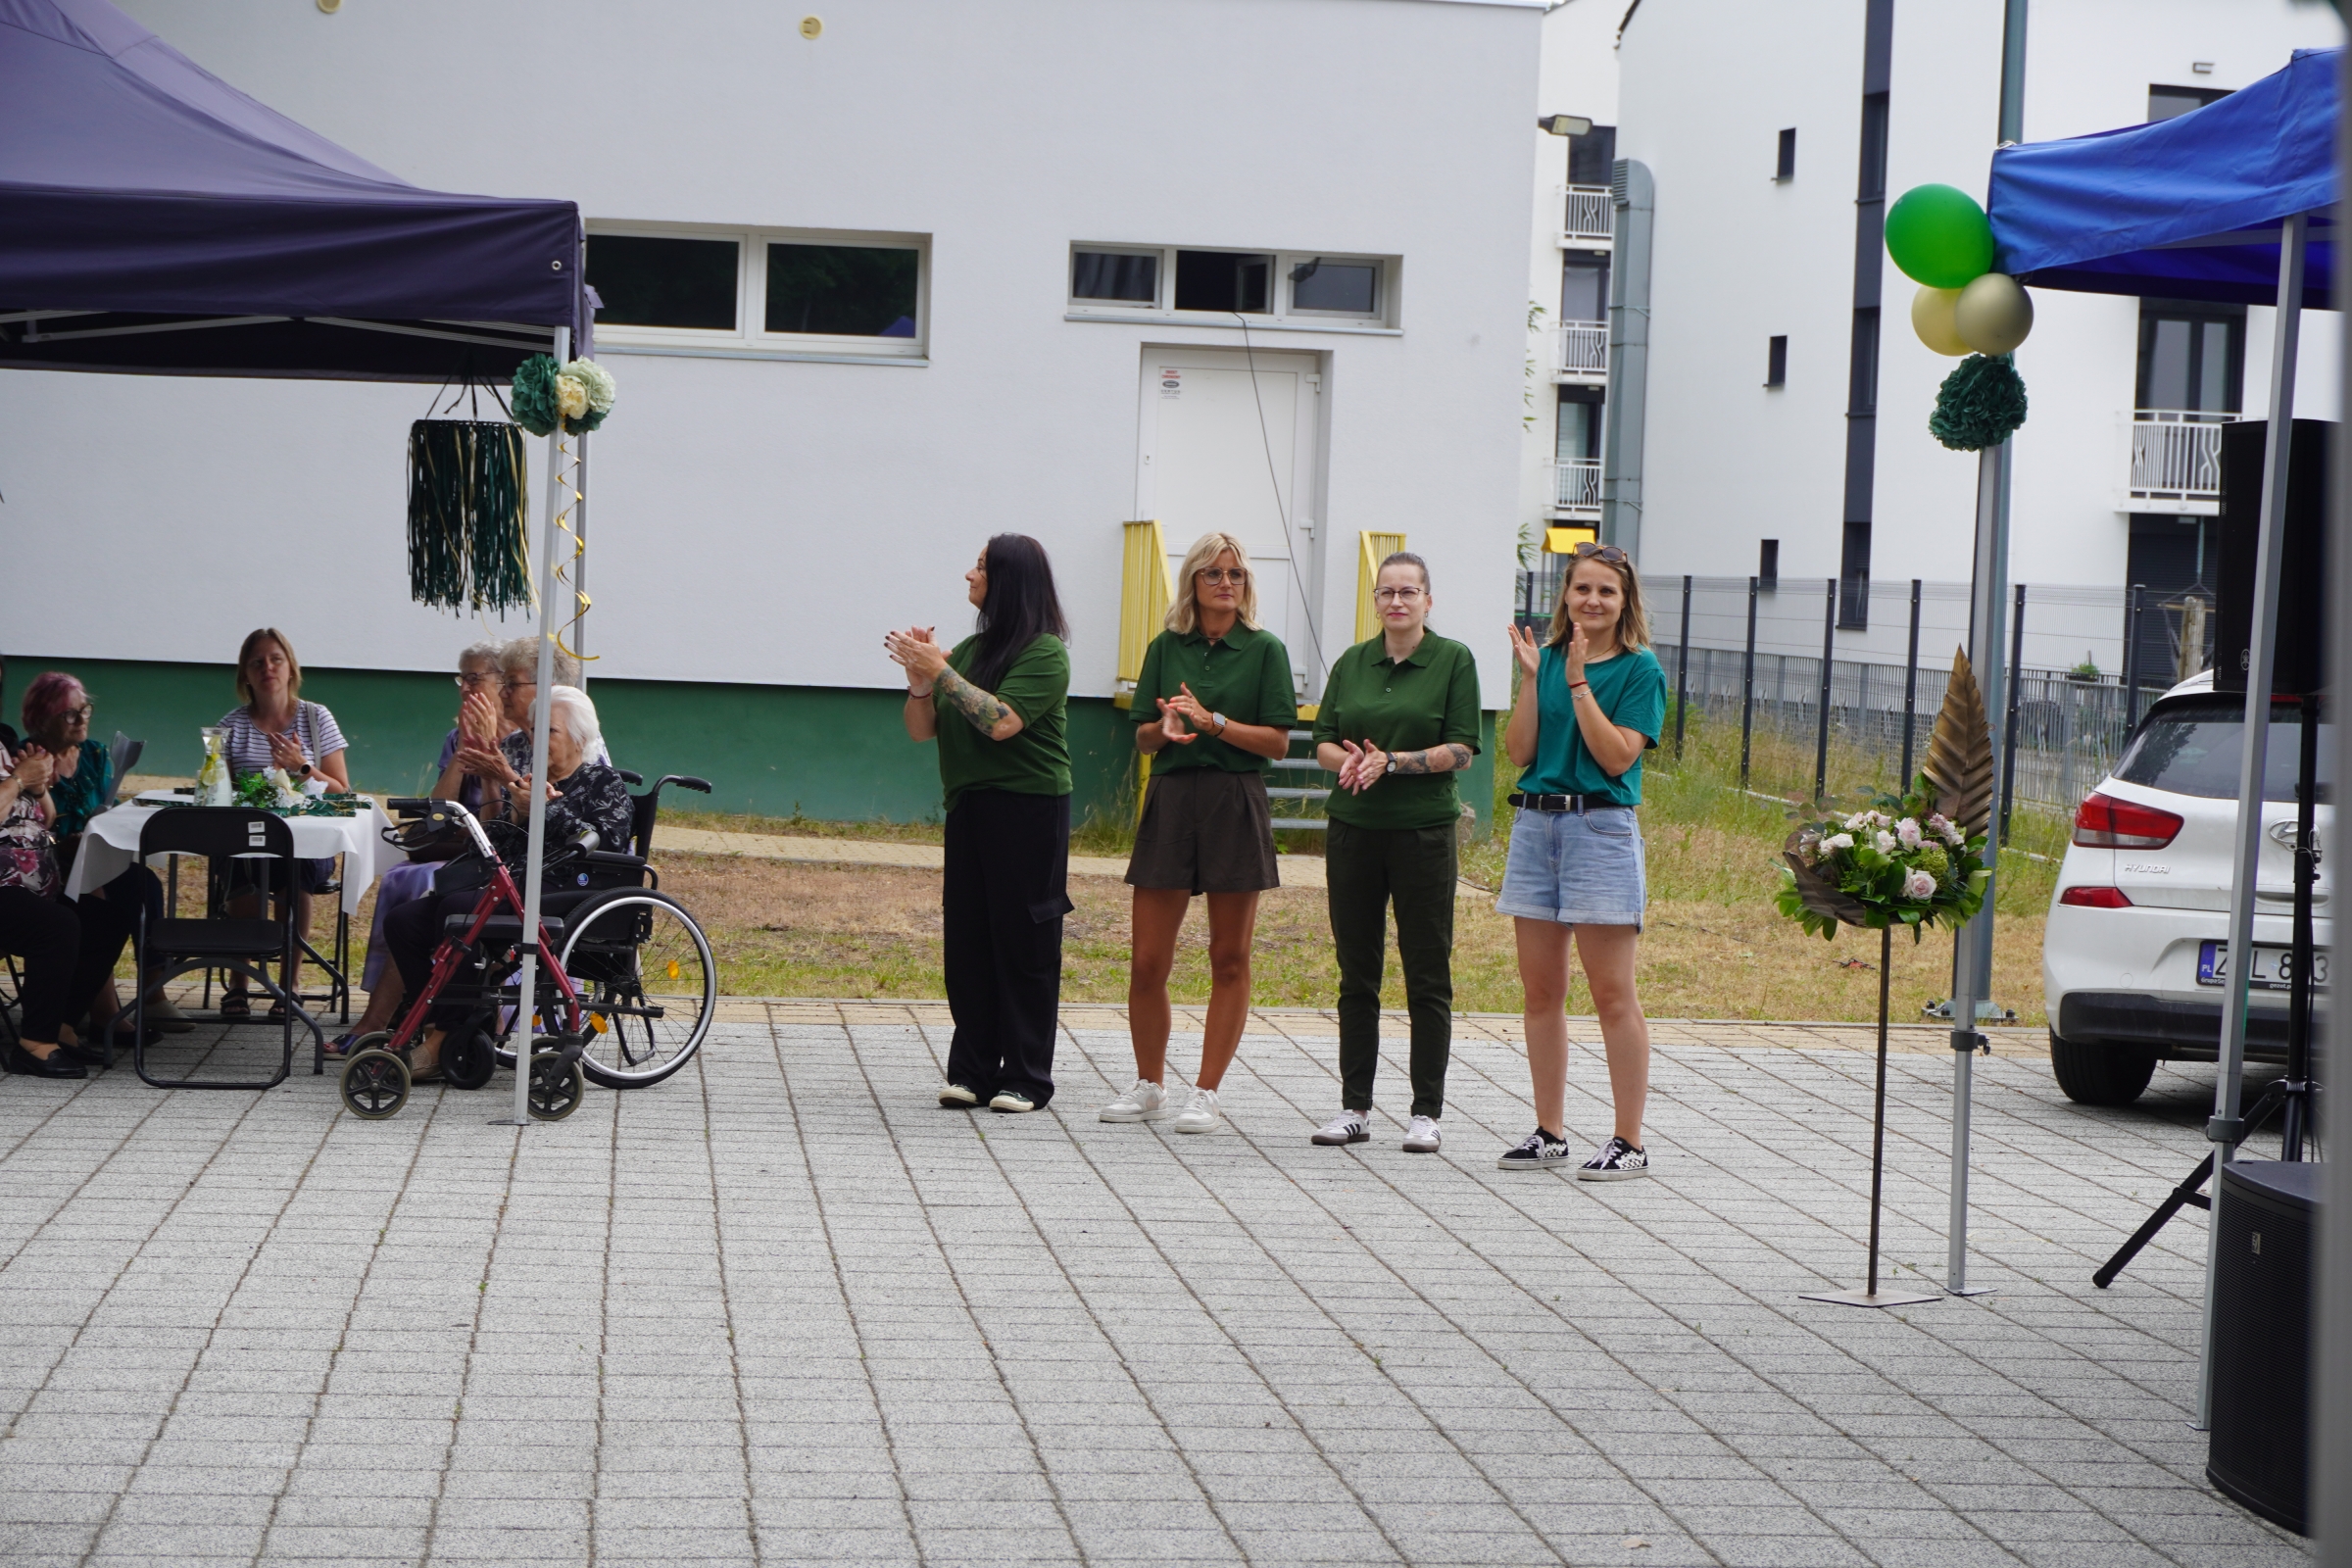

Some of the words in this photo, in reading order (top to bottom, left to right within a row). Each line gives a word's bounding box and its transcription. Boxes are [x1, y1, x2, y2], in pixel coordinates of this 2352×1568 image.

[2125, 863, 2171, 874] HYUNDAI
[2201, 964, 2212, 973] PL
[2215, 948, 2266, 979] ZL
[2278, 953, 2328, 983] 83
